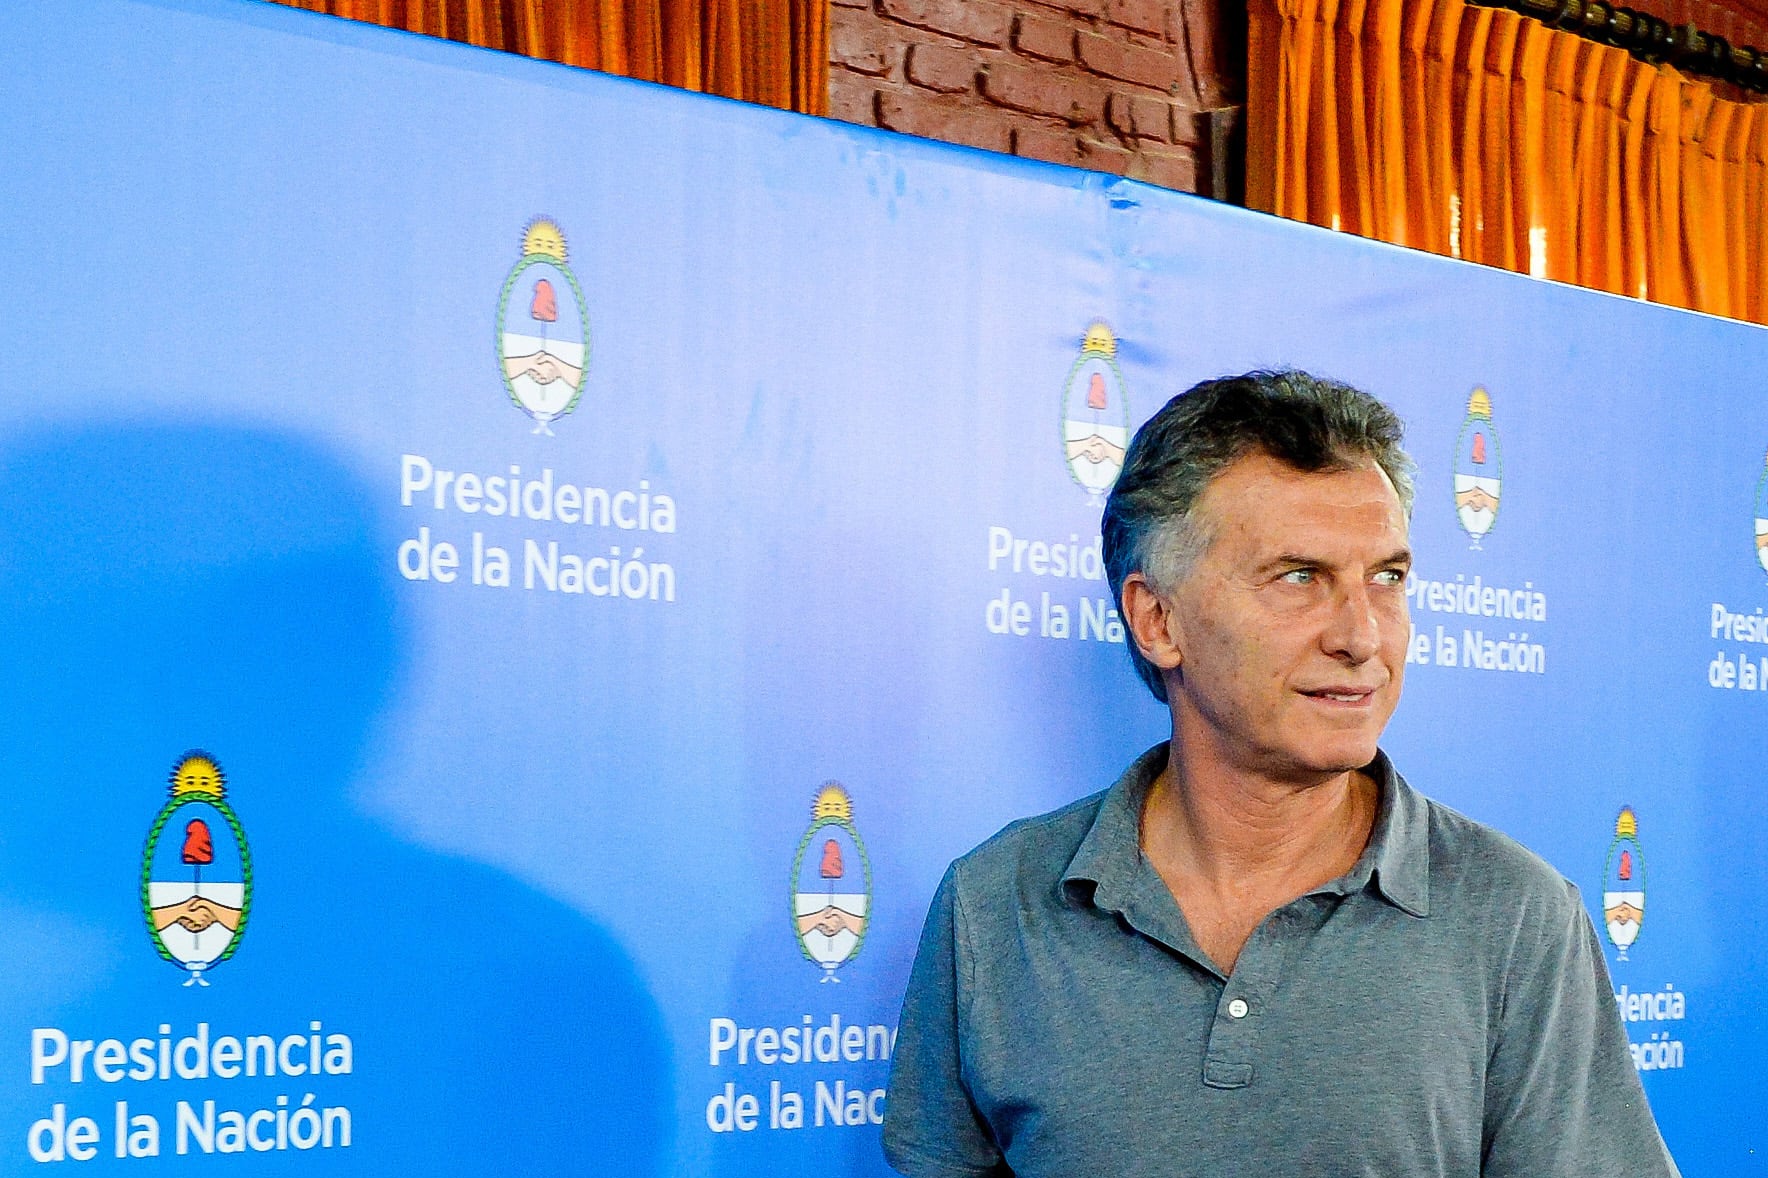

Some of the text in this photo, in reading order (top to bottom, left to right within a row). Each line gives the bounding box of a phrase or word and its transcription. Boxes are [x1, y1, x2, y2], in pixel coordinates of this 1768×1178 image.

[401, 454, 676, 533] Presidencia
[397, 527, 675, 602] de la Nación
[989, 526, 1103, 580] Presid
[985, 588, 1031, 636] de
[1041, 592, 1069, 639] la
[1436, 625, 1457, 667] la
[1463, 629, 1545, 673] Nación
[1708, 651, 1737, 688] de
[1739, 653, 1758, 690] la
[1615, 983, 1686, 1022] dencia
[31, 1020, 353, 1085] Presidencia
[709, 1013, 898, 1066] Presiden
[27, 1092, 351, 1163] de la Nación
[706, 1080, 886, 1133] de la Nac
